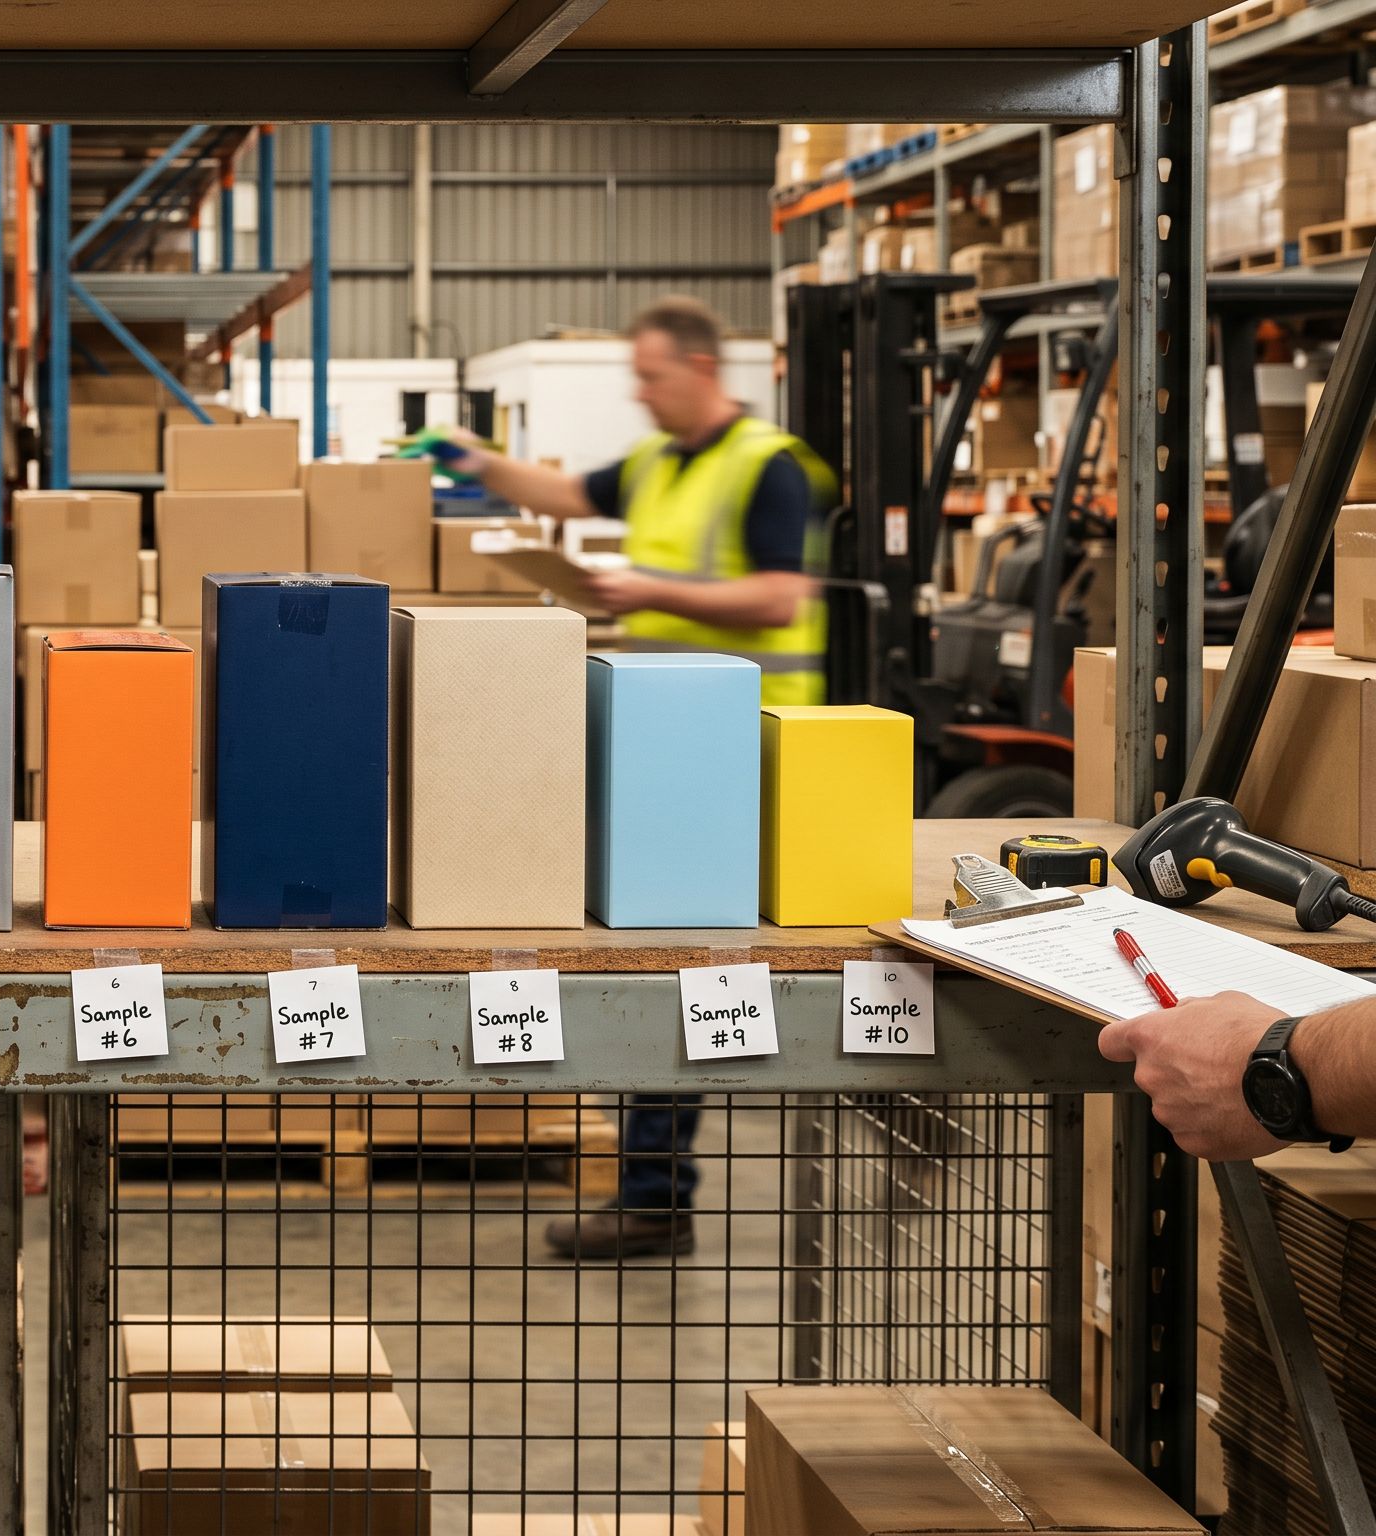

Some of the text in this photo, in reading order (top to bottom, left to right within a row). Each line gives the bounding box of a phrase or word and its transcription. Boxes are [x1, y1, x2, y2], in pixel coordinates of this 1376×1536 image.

[111, 978, 120, 989] 6
[309, 980, 318, 991] 7
[510, 980, 519, 991] 8
[718, 976, 728, 987] 9
[885, 972, 898, 983] 10
[80, 1000, 152, 1027] Sample
[278, 1002, 350, 1028] Sample
[477, 1005, 549, 1031] Sample
[689, 999, 761, 1026] Sample
[850, 997, 921, 1024] Sample
[101, 1028, 138, 1049] #6
[299, 1031, 334, 1050] #7
[498, 1032, 533, 1053] #8
[711, 1028, 746, 1048] #9
[864, 1025, 909, 1044] #10
